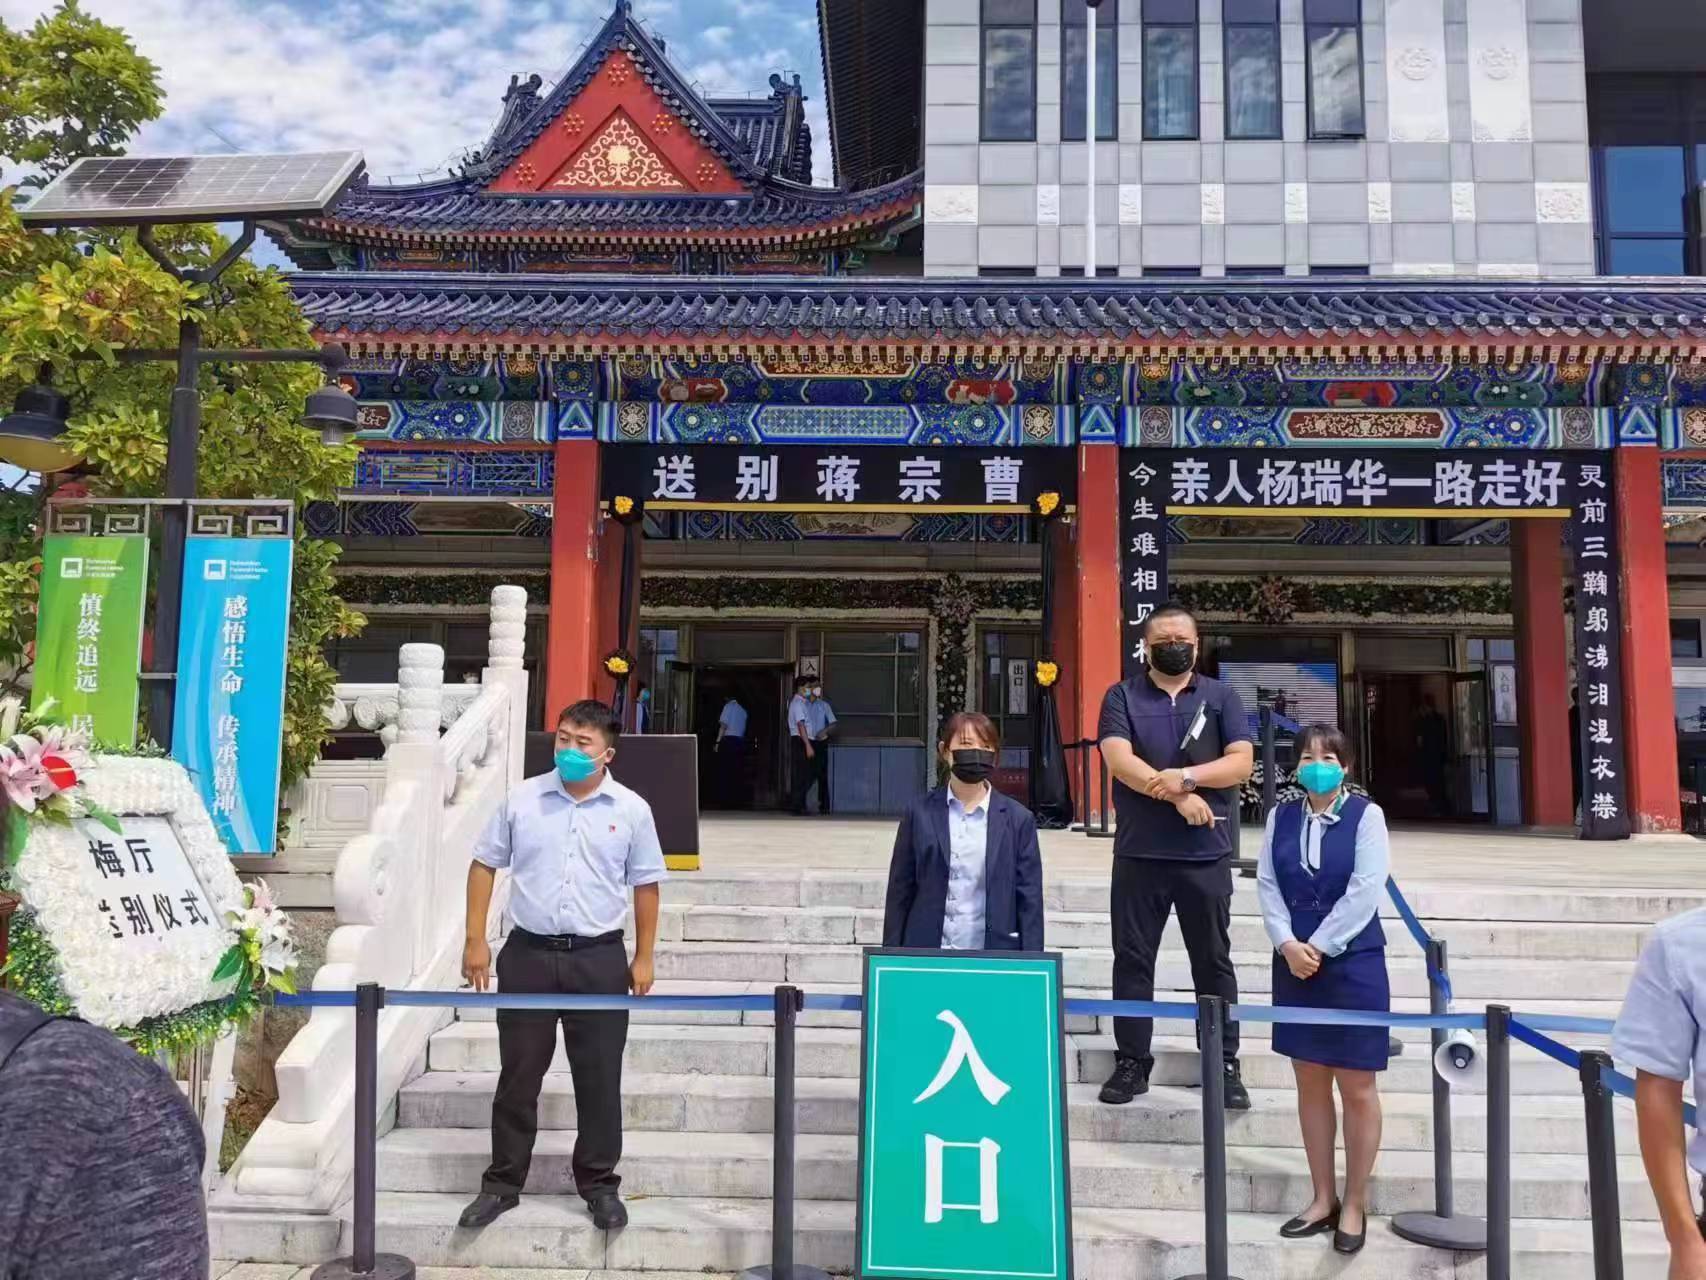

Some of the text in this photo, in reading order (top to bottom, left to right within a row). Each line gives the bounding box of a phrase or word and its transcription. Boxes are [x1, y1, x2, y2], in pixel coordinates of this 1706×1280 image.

[653, 455, 1023, 503] 送别蒋宗曹
[1170, 458, 1566, 507] 亲人杨瑞华一路走好
[75, 593, 102, 692] 慎终追远
[220, 595, 248, 694] 感悟生命
[1578, 465, 1618, 819] 灵前三鞠躬涕泪湿衣襟
[89, 839, 153, 879] 梅厅
[912, 1009, 1012, 1223] 入口
